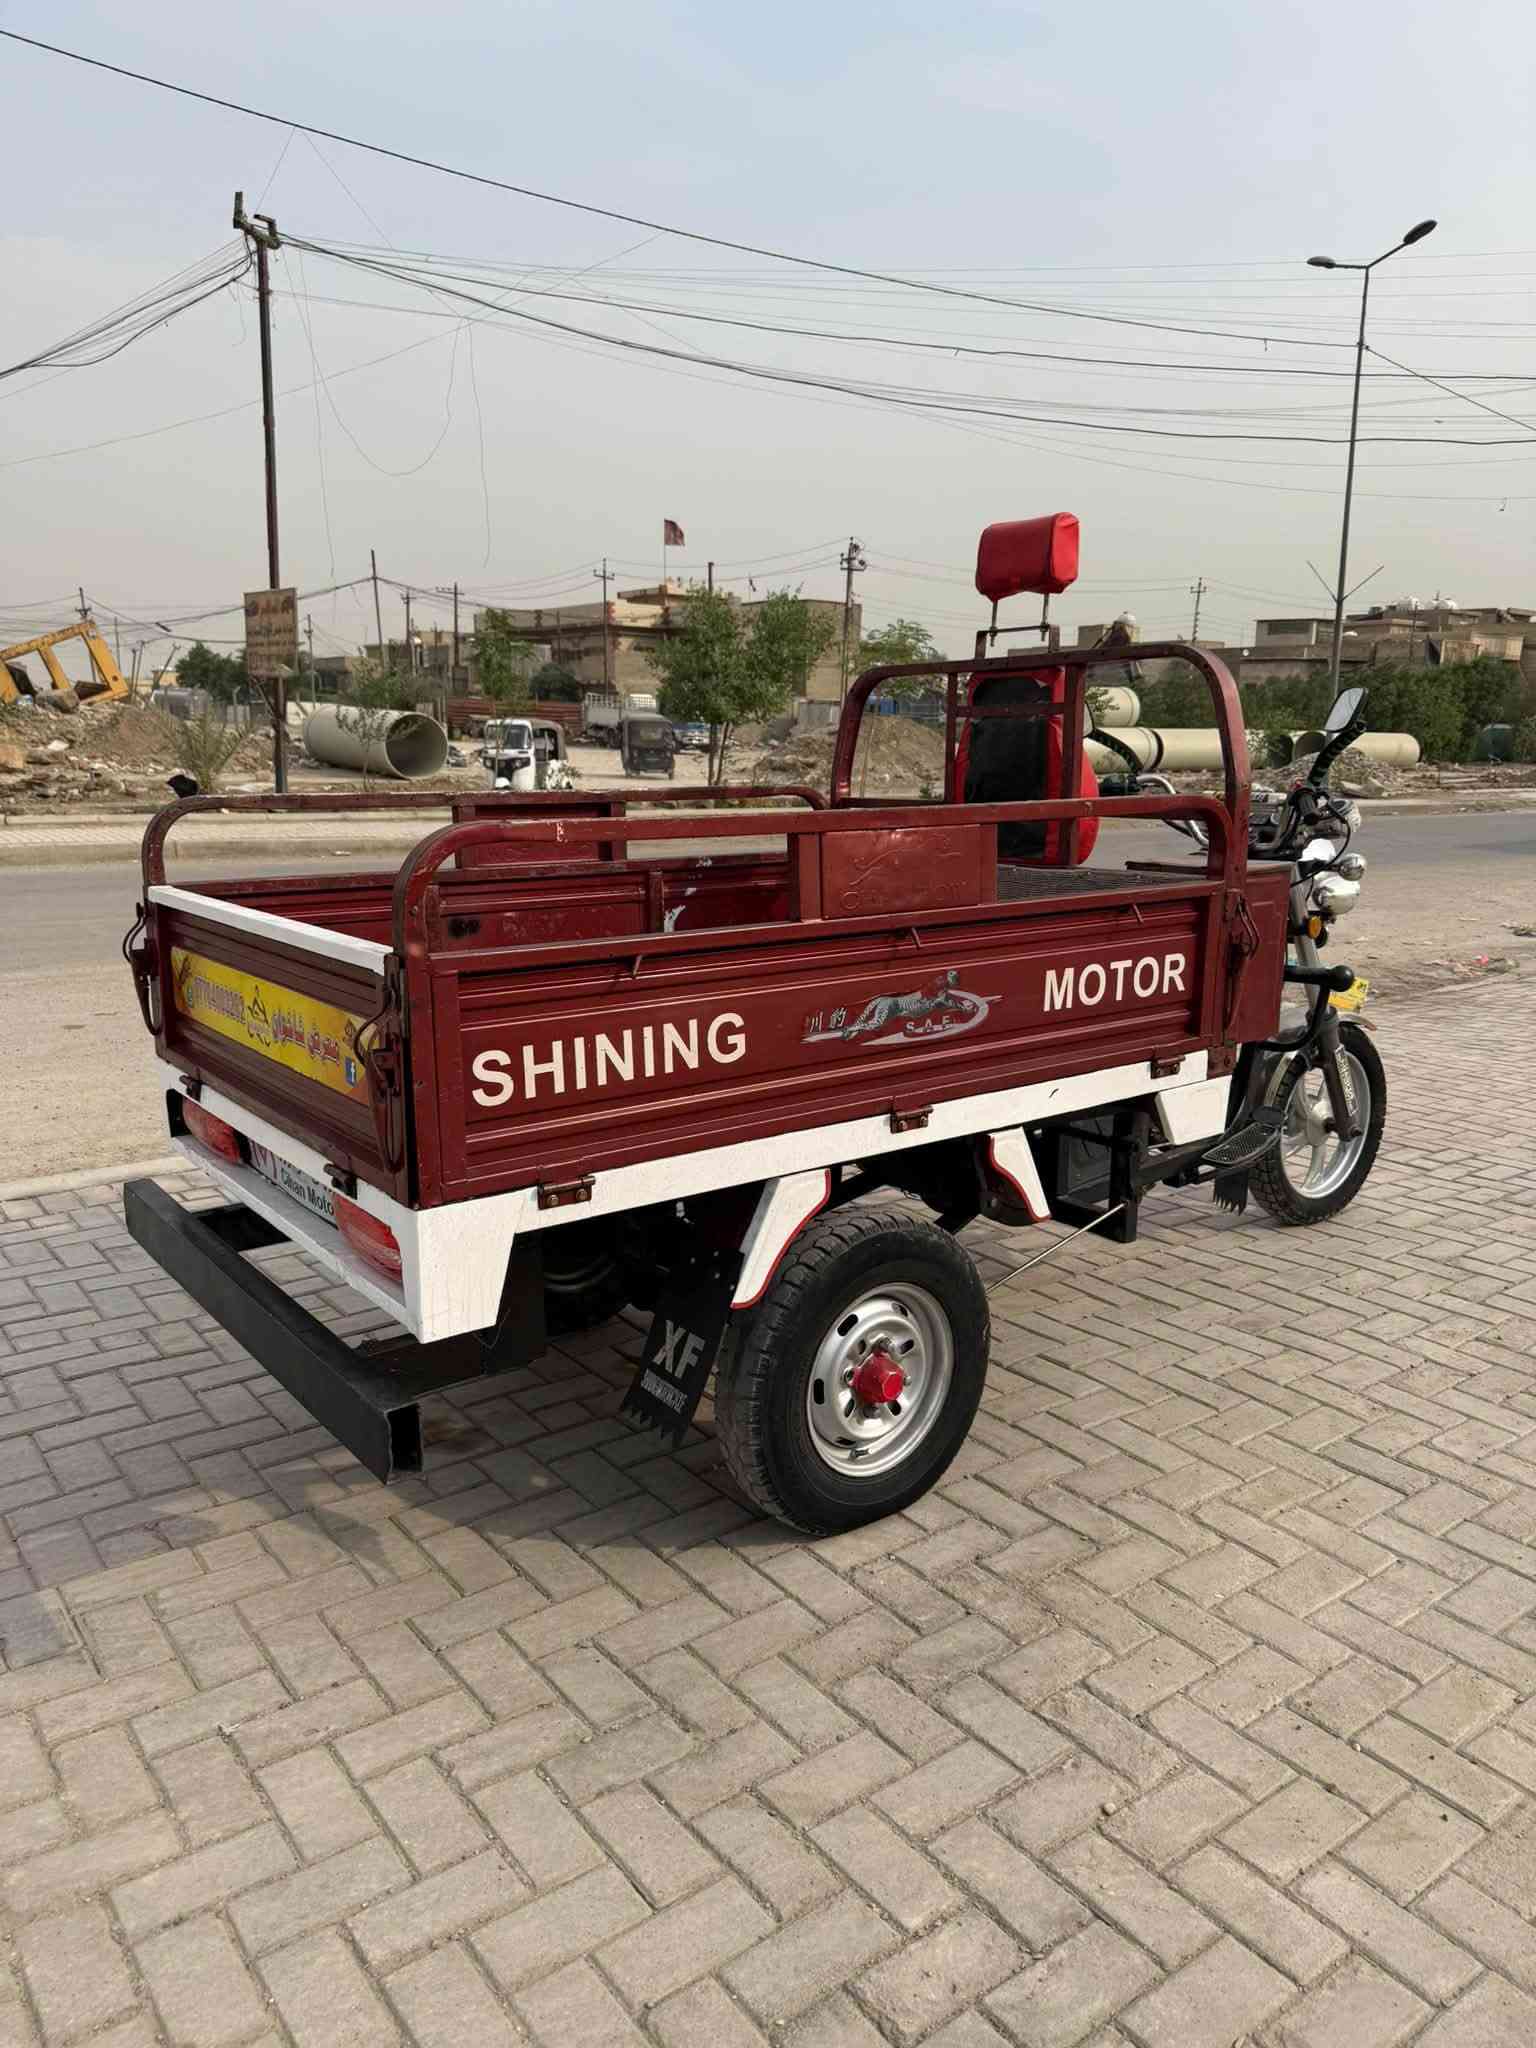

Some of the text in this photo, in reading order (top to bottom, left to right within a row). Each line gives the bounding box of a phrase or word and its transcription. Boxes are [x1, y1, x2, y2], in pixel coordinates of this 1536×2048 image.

[1043, 952, 1186, 1013] MOTOR
[471, 1012, 746, 1107] SHINING
[652, 1319, 705, 1379] XF
